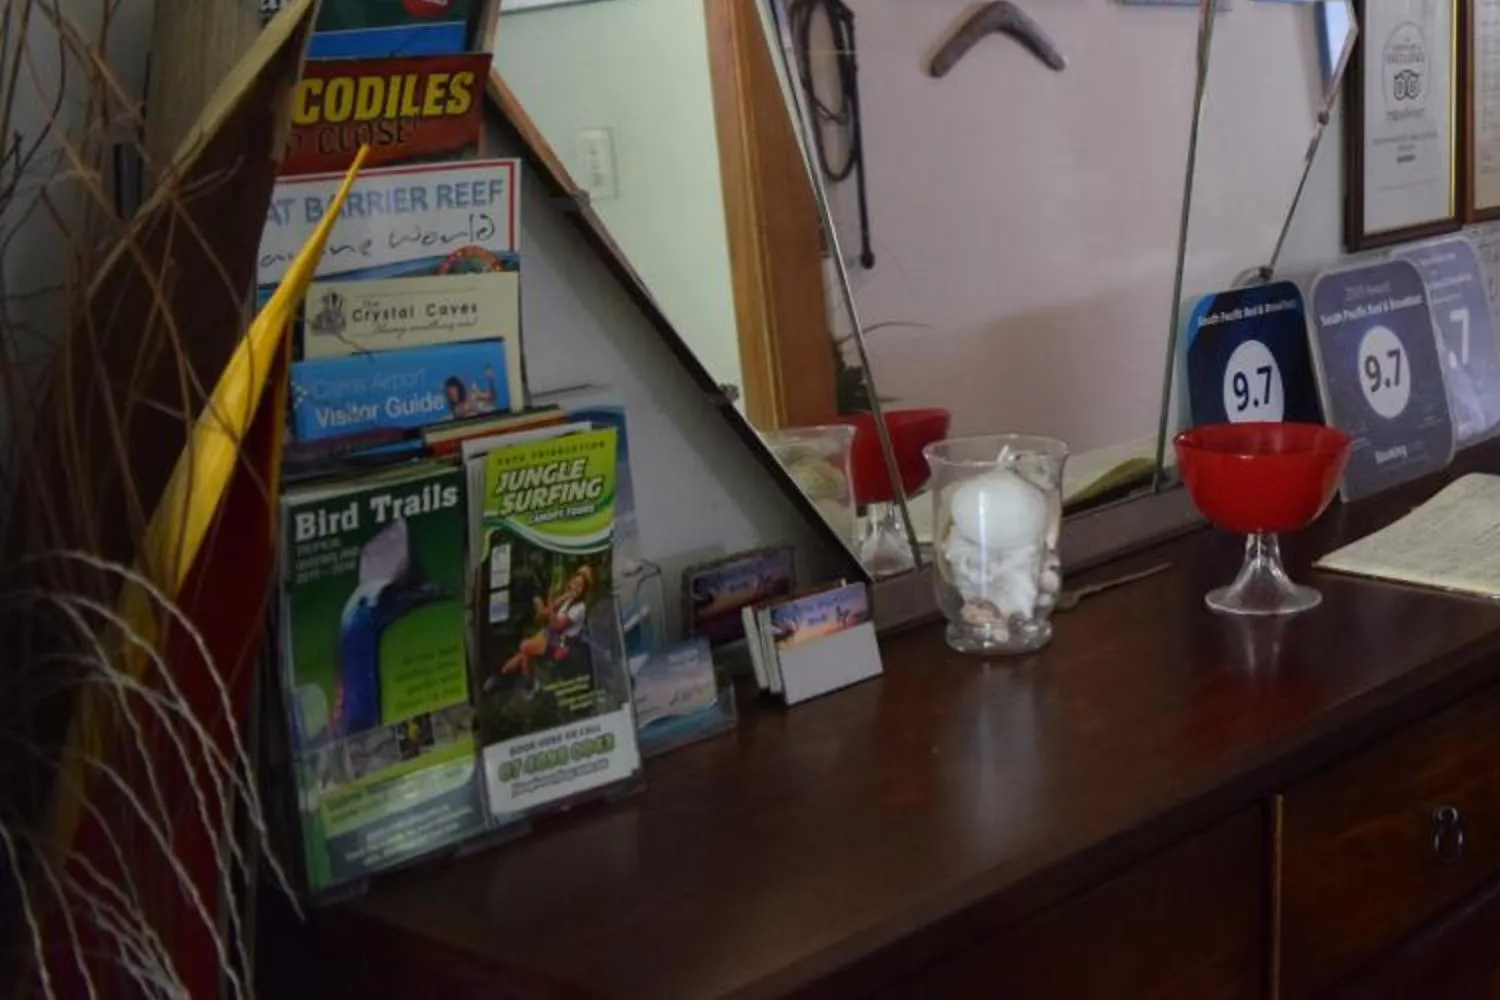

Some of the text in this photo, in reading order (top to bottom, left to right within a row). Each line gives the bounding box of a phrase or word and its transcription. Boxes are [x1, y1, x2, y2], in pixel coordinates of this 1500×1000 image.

[437, 179, 504, 209] REEF
[351, 302, 478, 324] Crystal Caves
[1233, 365, 1273, 412] 9.7
[1364, 349, 1402, 394] 9.7
[315, 390, 445, 428] Visitor Guide
[495, 457, 588, 495] JUNGLE
[294, 484, 459, 543] Bird Trails
[499, 476, 605, 516] SURFING
